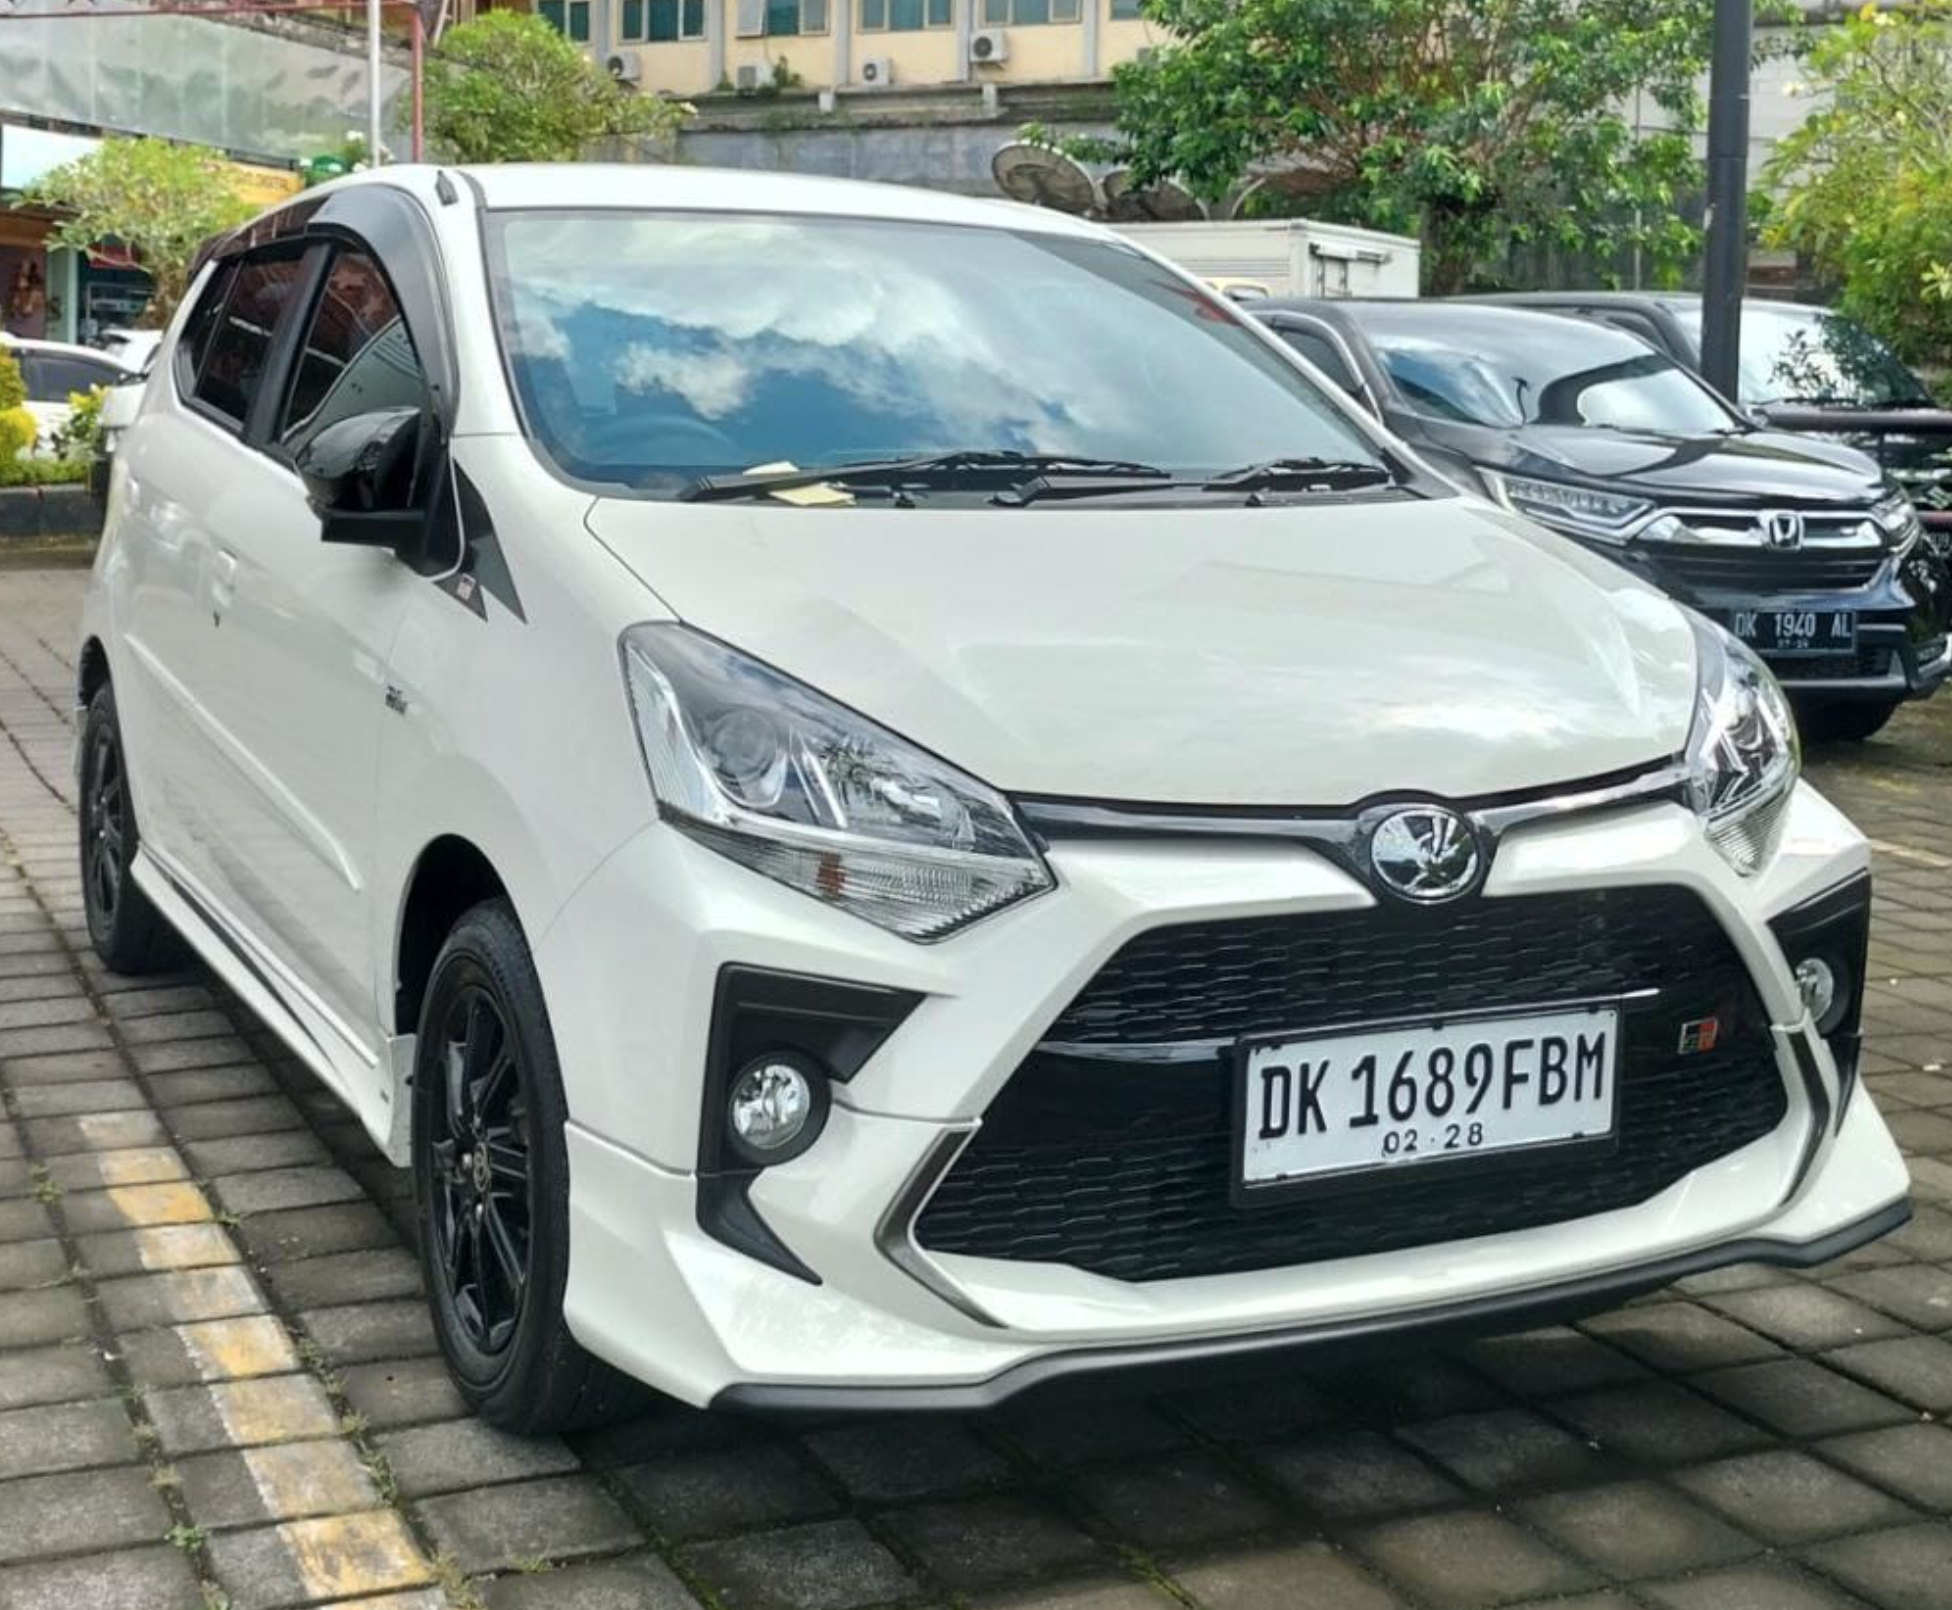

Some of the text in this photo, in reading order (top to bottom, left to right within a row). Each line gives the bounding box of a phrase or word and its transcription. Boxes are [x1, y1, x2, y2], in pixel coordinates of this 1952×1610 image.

[1734, 613, 1852, 638] DK 1940 AL
[1258, 1060, 1330, 1140] DK
